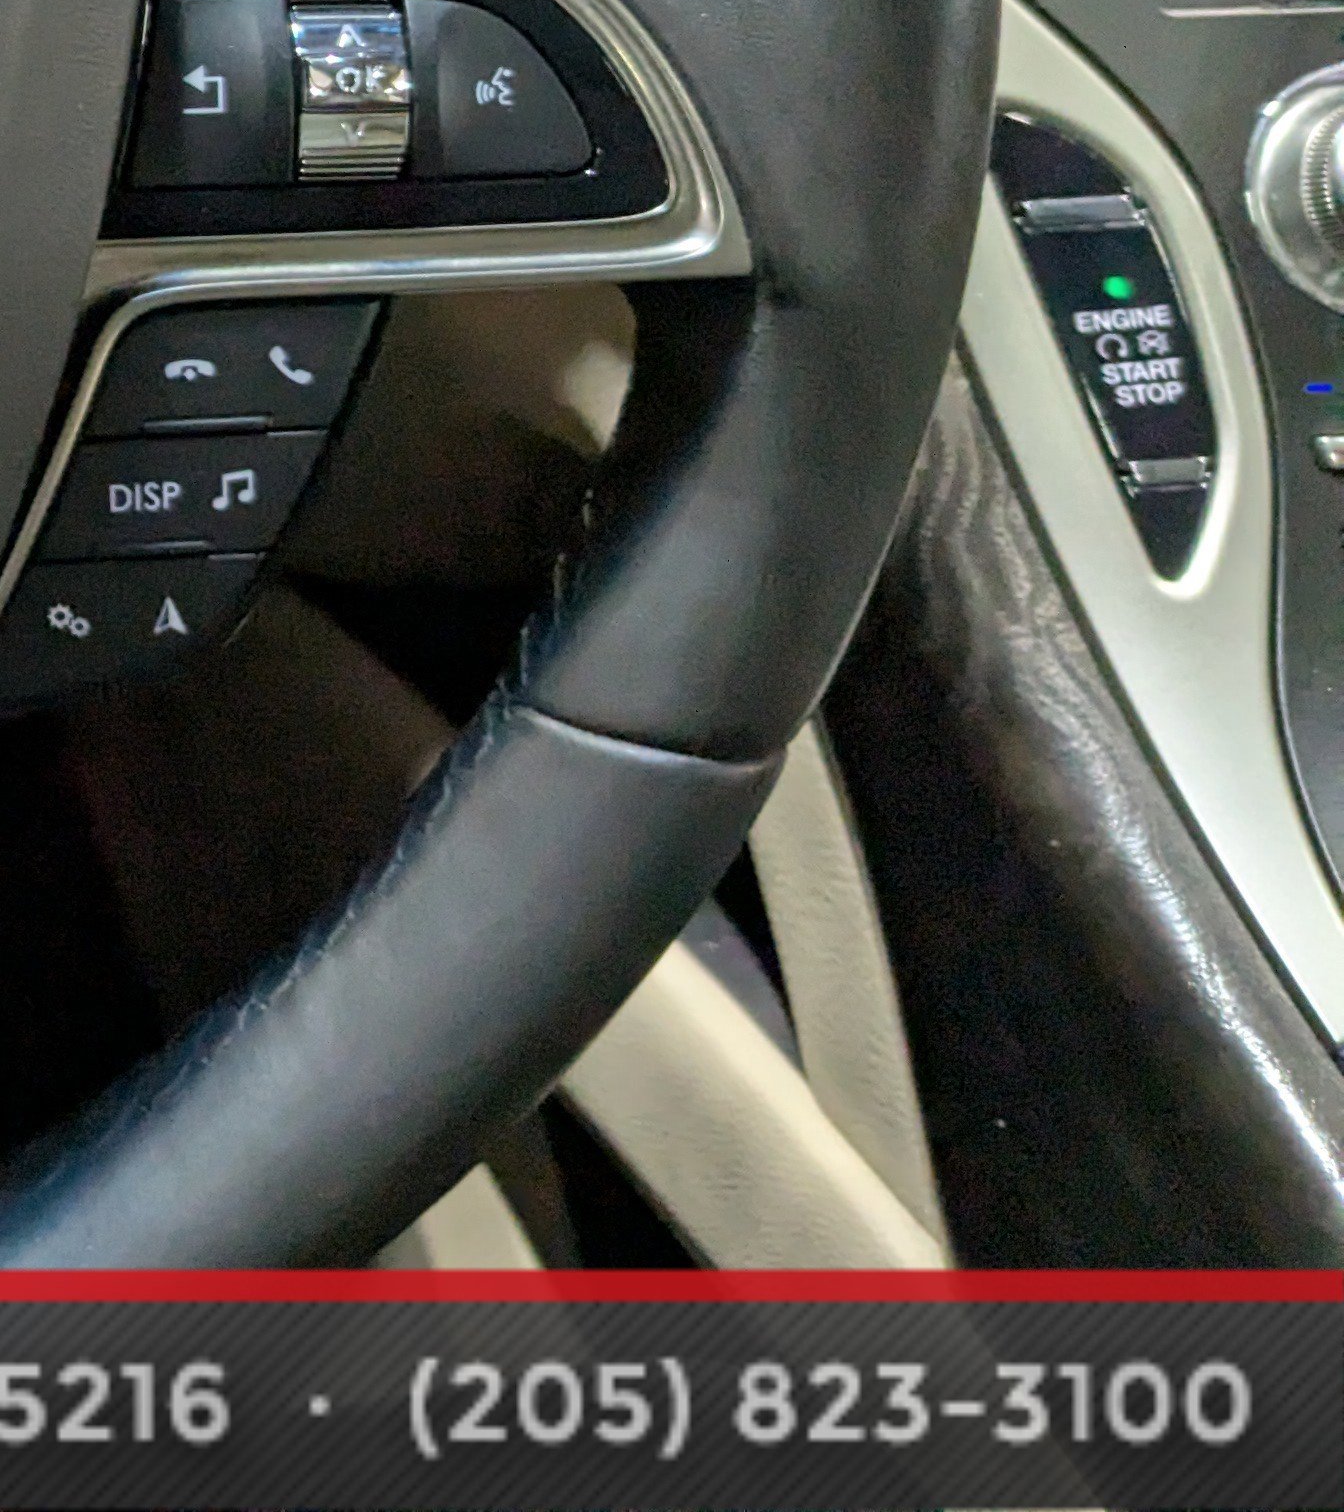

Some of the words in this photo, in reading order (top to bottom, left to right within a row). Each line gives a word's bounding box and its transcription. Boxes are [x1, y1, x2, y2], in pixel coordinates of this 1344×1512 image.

[335, 65, 386, 93] OK
[1075, 304, 1172, 333] ENGINE
[1100, 357, 1183, 386] START
[1114, 383, 1184, 408] STOP
[108, 481, 181, 514] DISP
